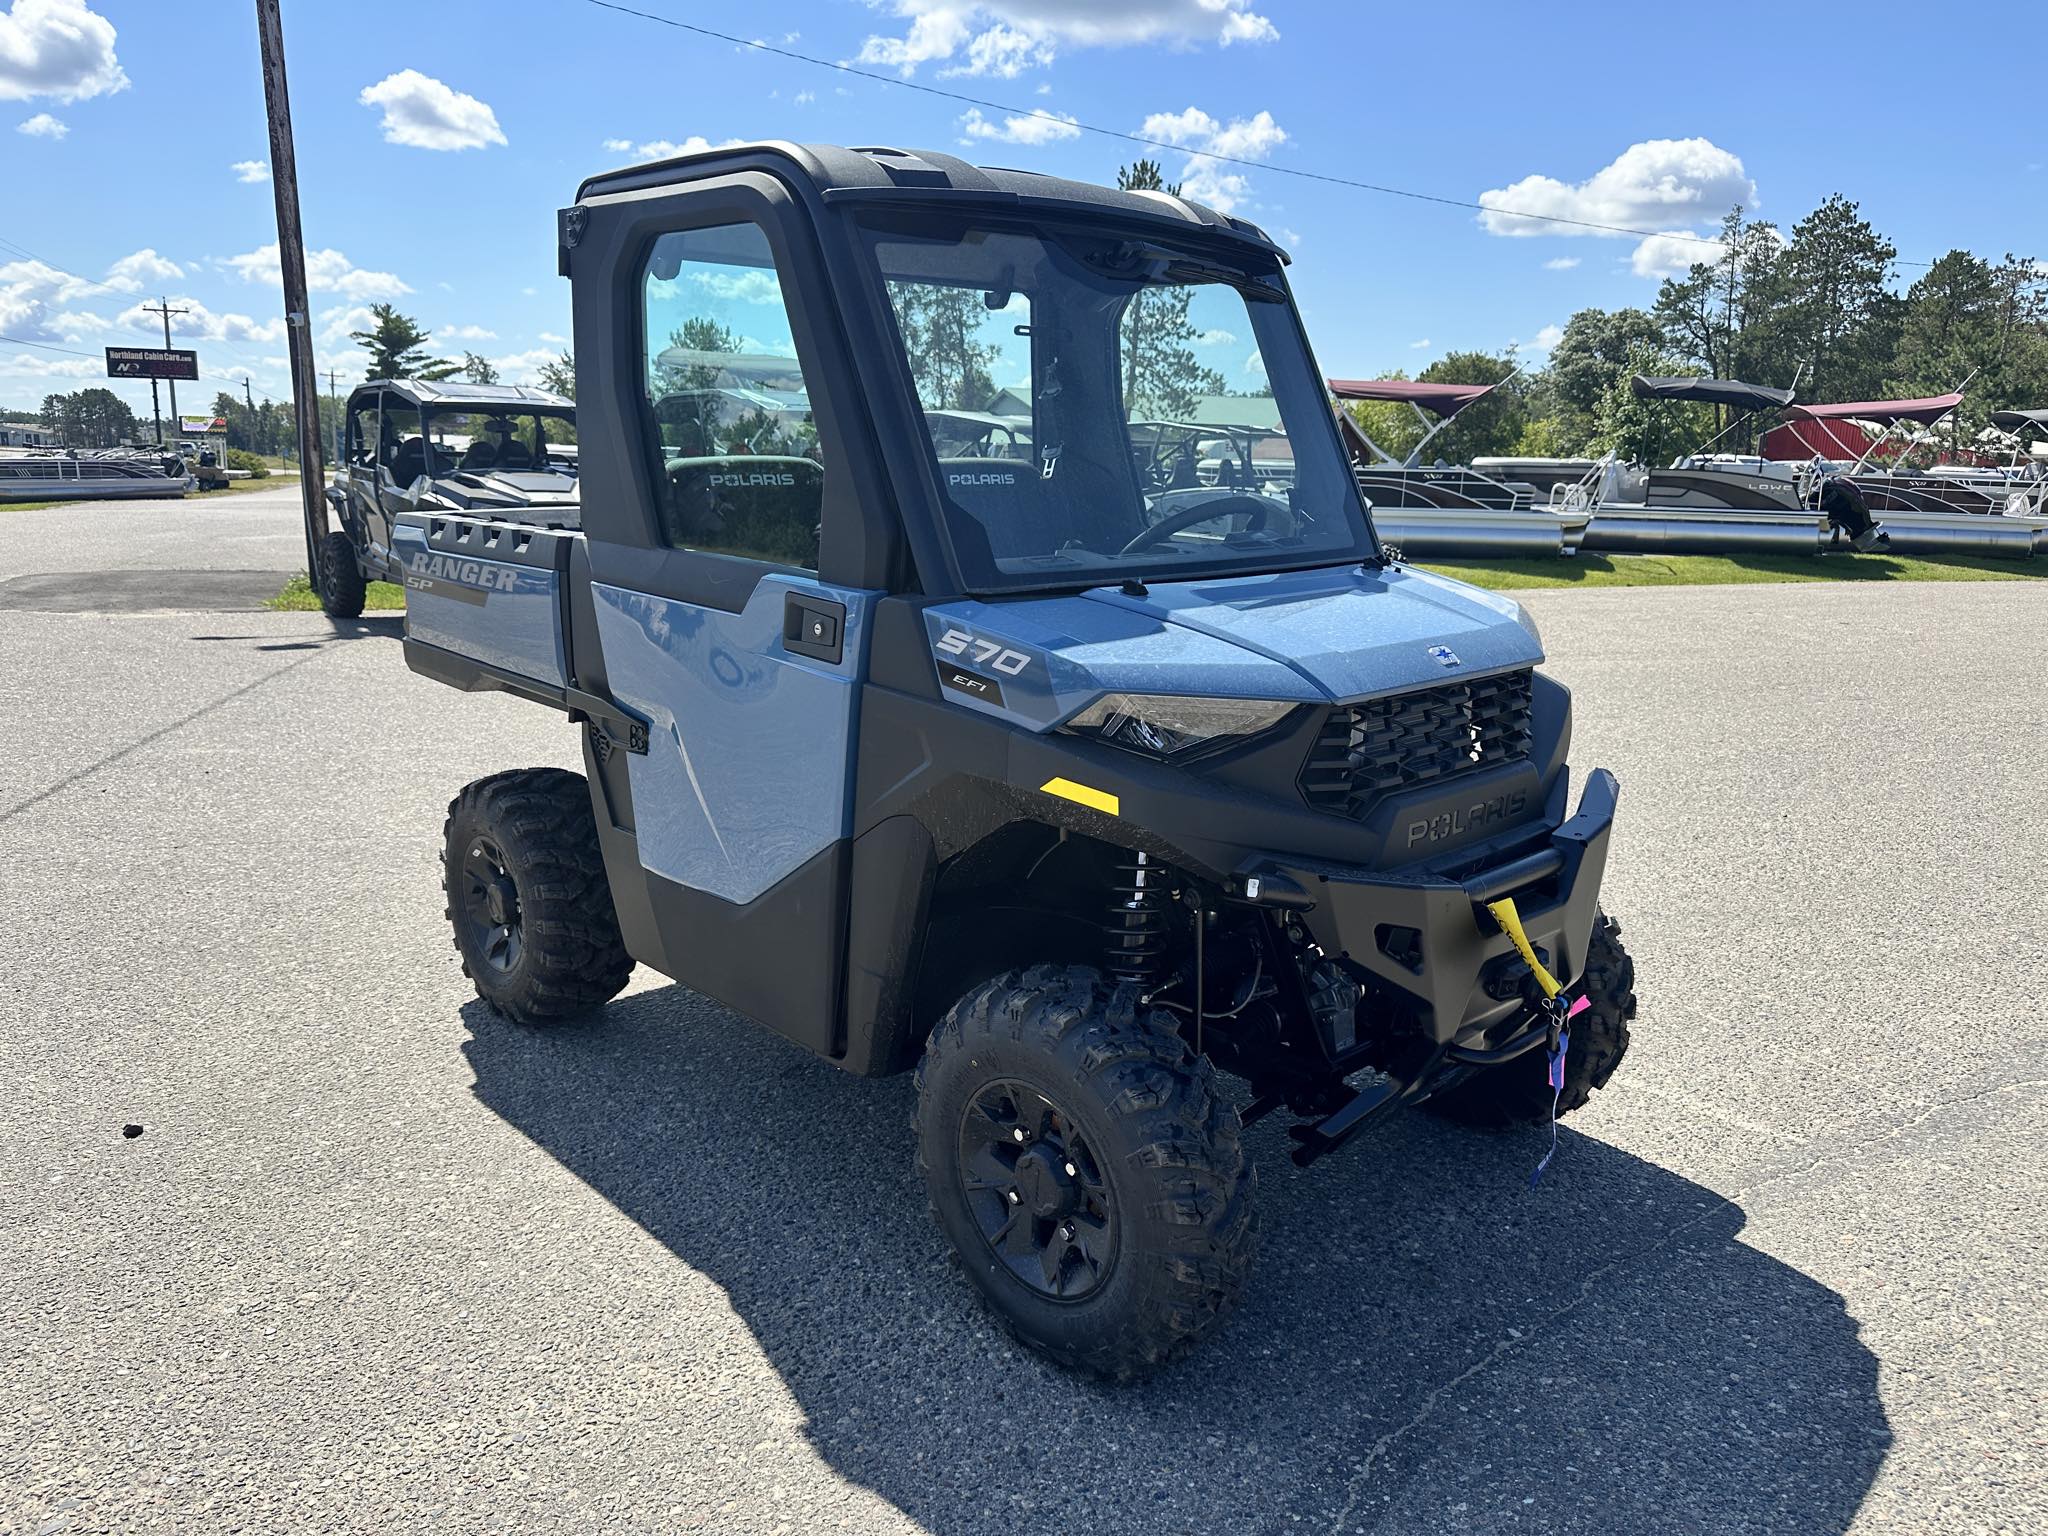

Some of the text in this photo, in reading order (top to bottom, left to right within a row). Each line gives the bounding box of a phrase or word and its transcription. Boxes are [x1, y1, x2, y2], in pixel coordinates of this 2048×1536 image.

[109, 350, 143, 360] Northland
[144, 351, 164, 361] Cabin
[709, 473, 795, 487] POLARIS
[949, 474, 1015, 486] POLARIS
[411, 551, 518, 593] RANGER
[406, 576, 434, 591] SP
[936, 628, 1032, 676] 570
[952, 674, 987, 692] EFI
[1407, 788, 1527, 849] POLARIS
